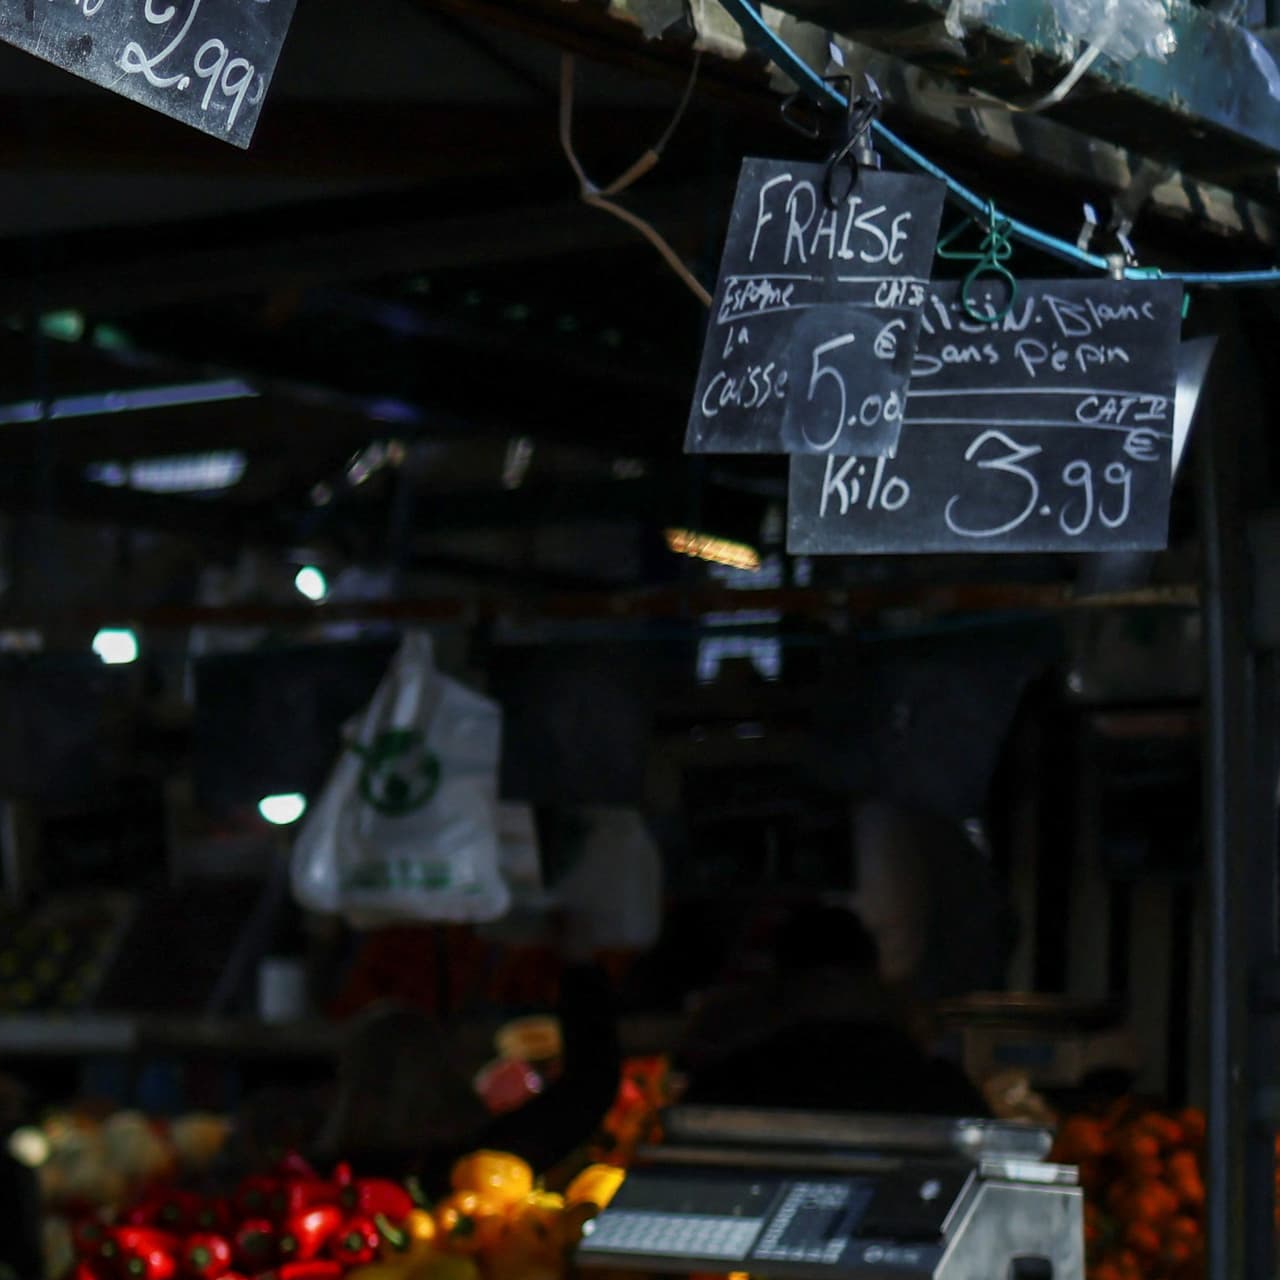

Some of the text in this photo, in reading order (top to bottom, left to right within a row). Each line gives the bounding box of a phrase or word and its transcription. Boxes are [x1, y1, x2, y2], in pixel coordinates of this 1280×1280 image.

[749, 173, 912, 264] FRAISE
[820, 430, 1132, 537] Kilo 3.99
